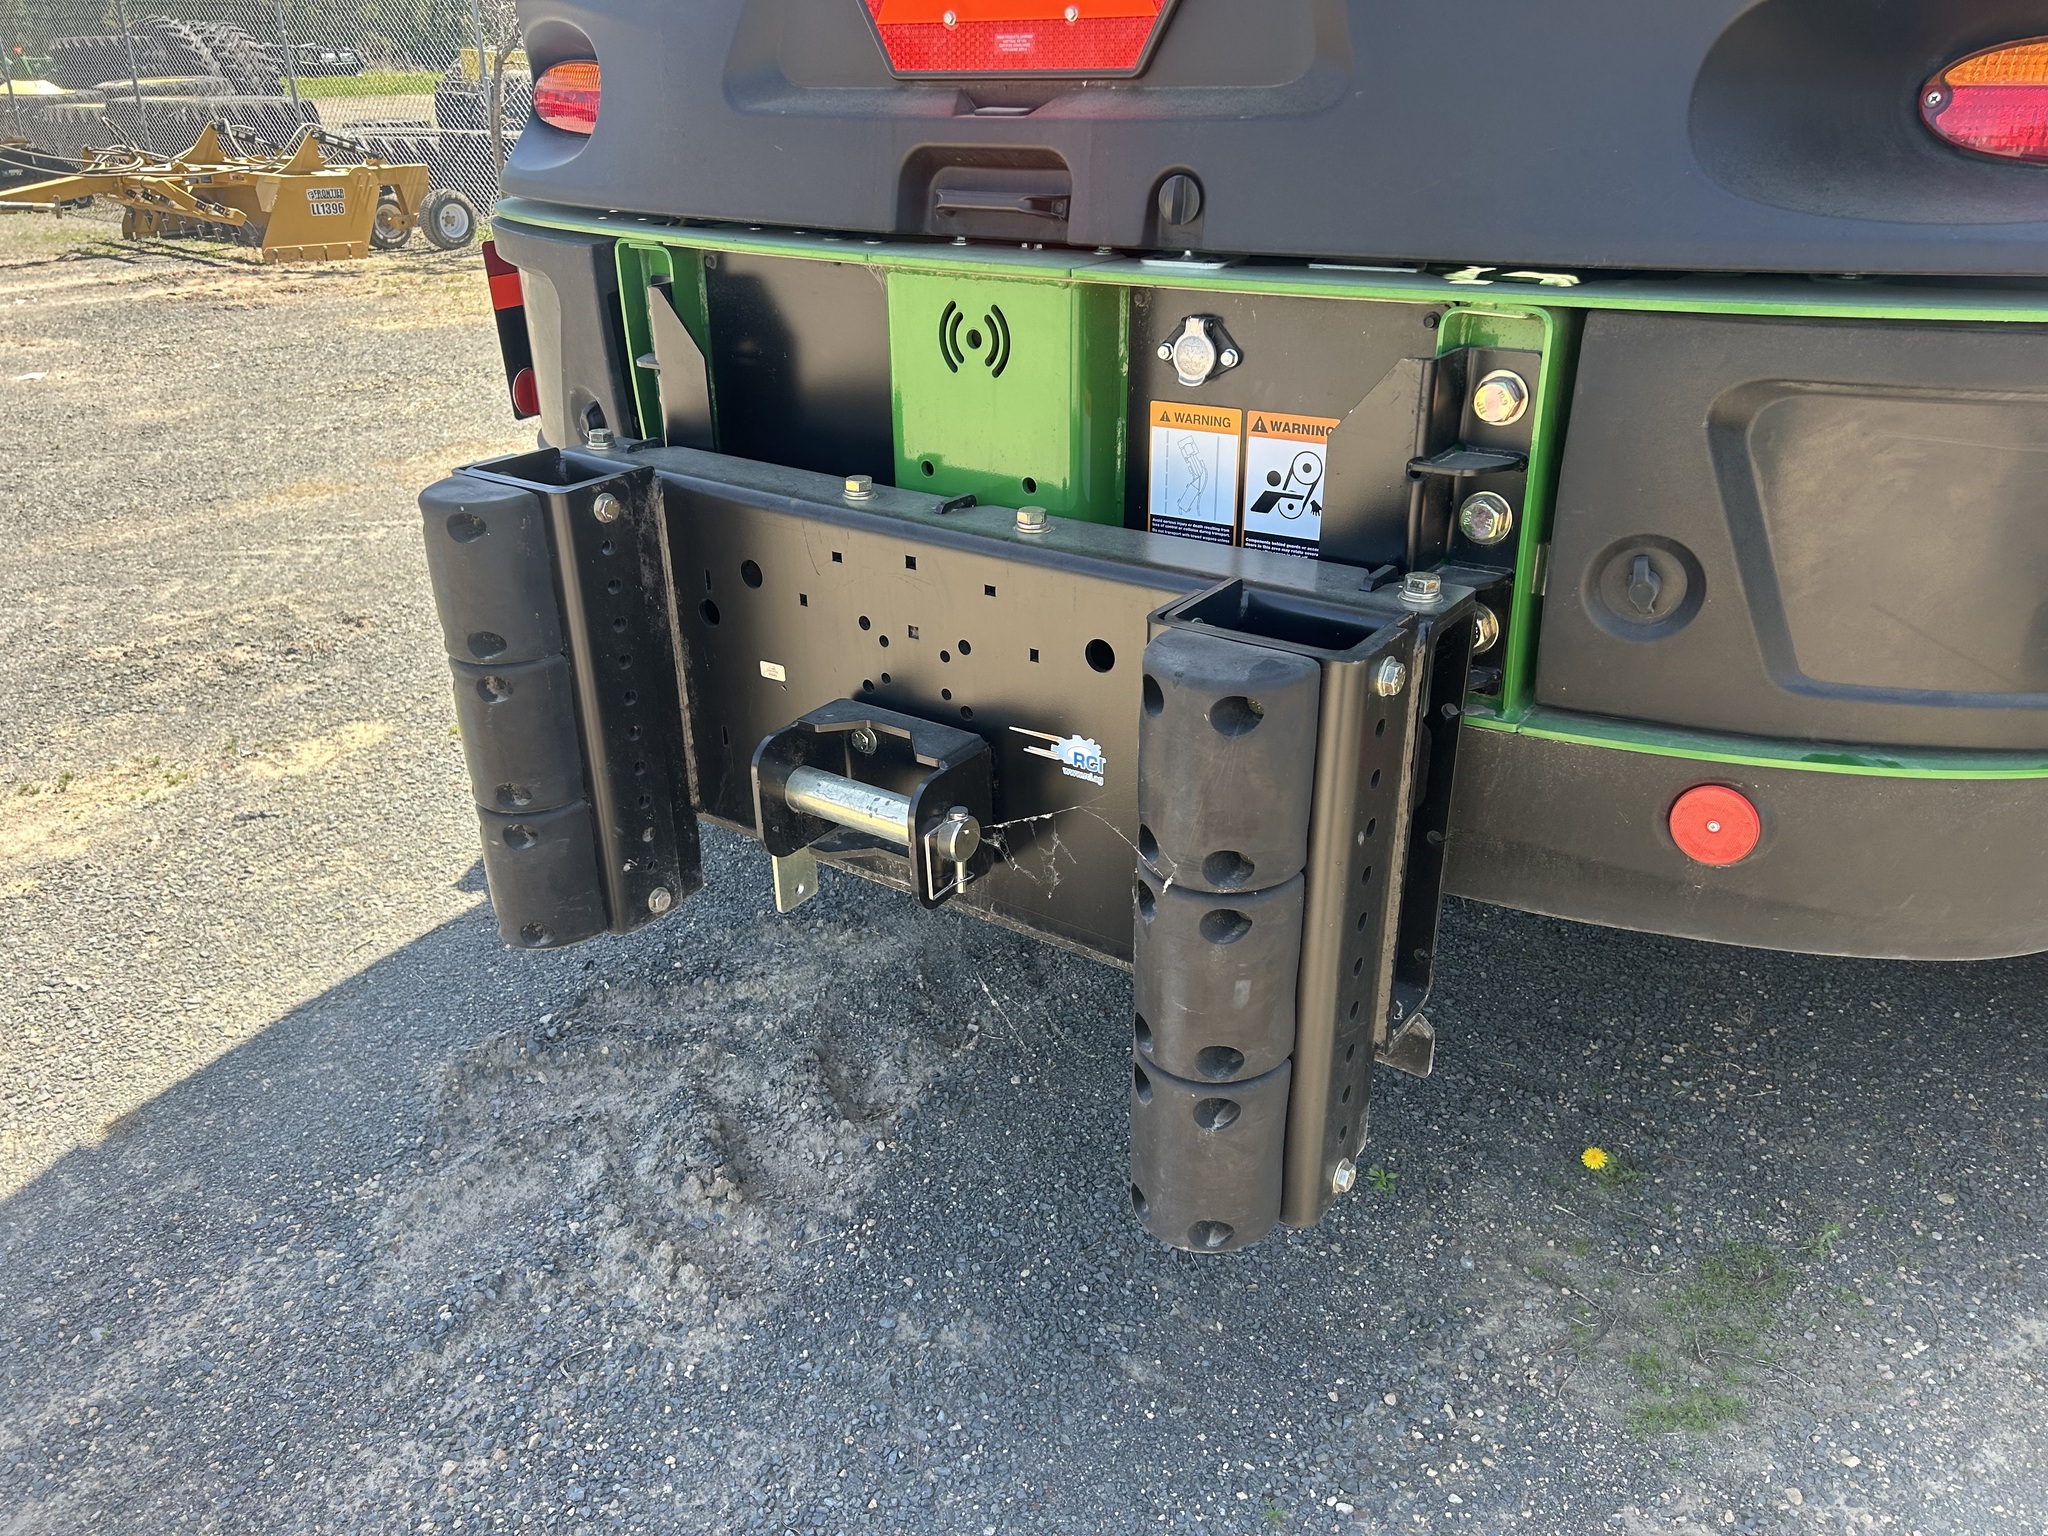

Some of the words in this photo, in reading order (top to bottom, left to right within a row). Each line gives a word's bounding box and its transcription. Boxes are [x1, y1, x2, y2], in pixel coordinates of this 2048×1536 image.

[311, 202, 345, 215] LL1396
[1174, 412, 1231, 428] WARNING
[1073, 752, 1103, 773] RCI
